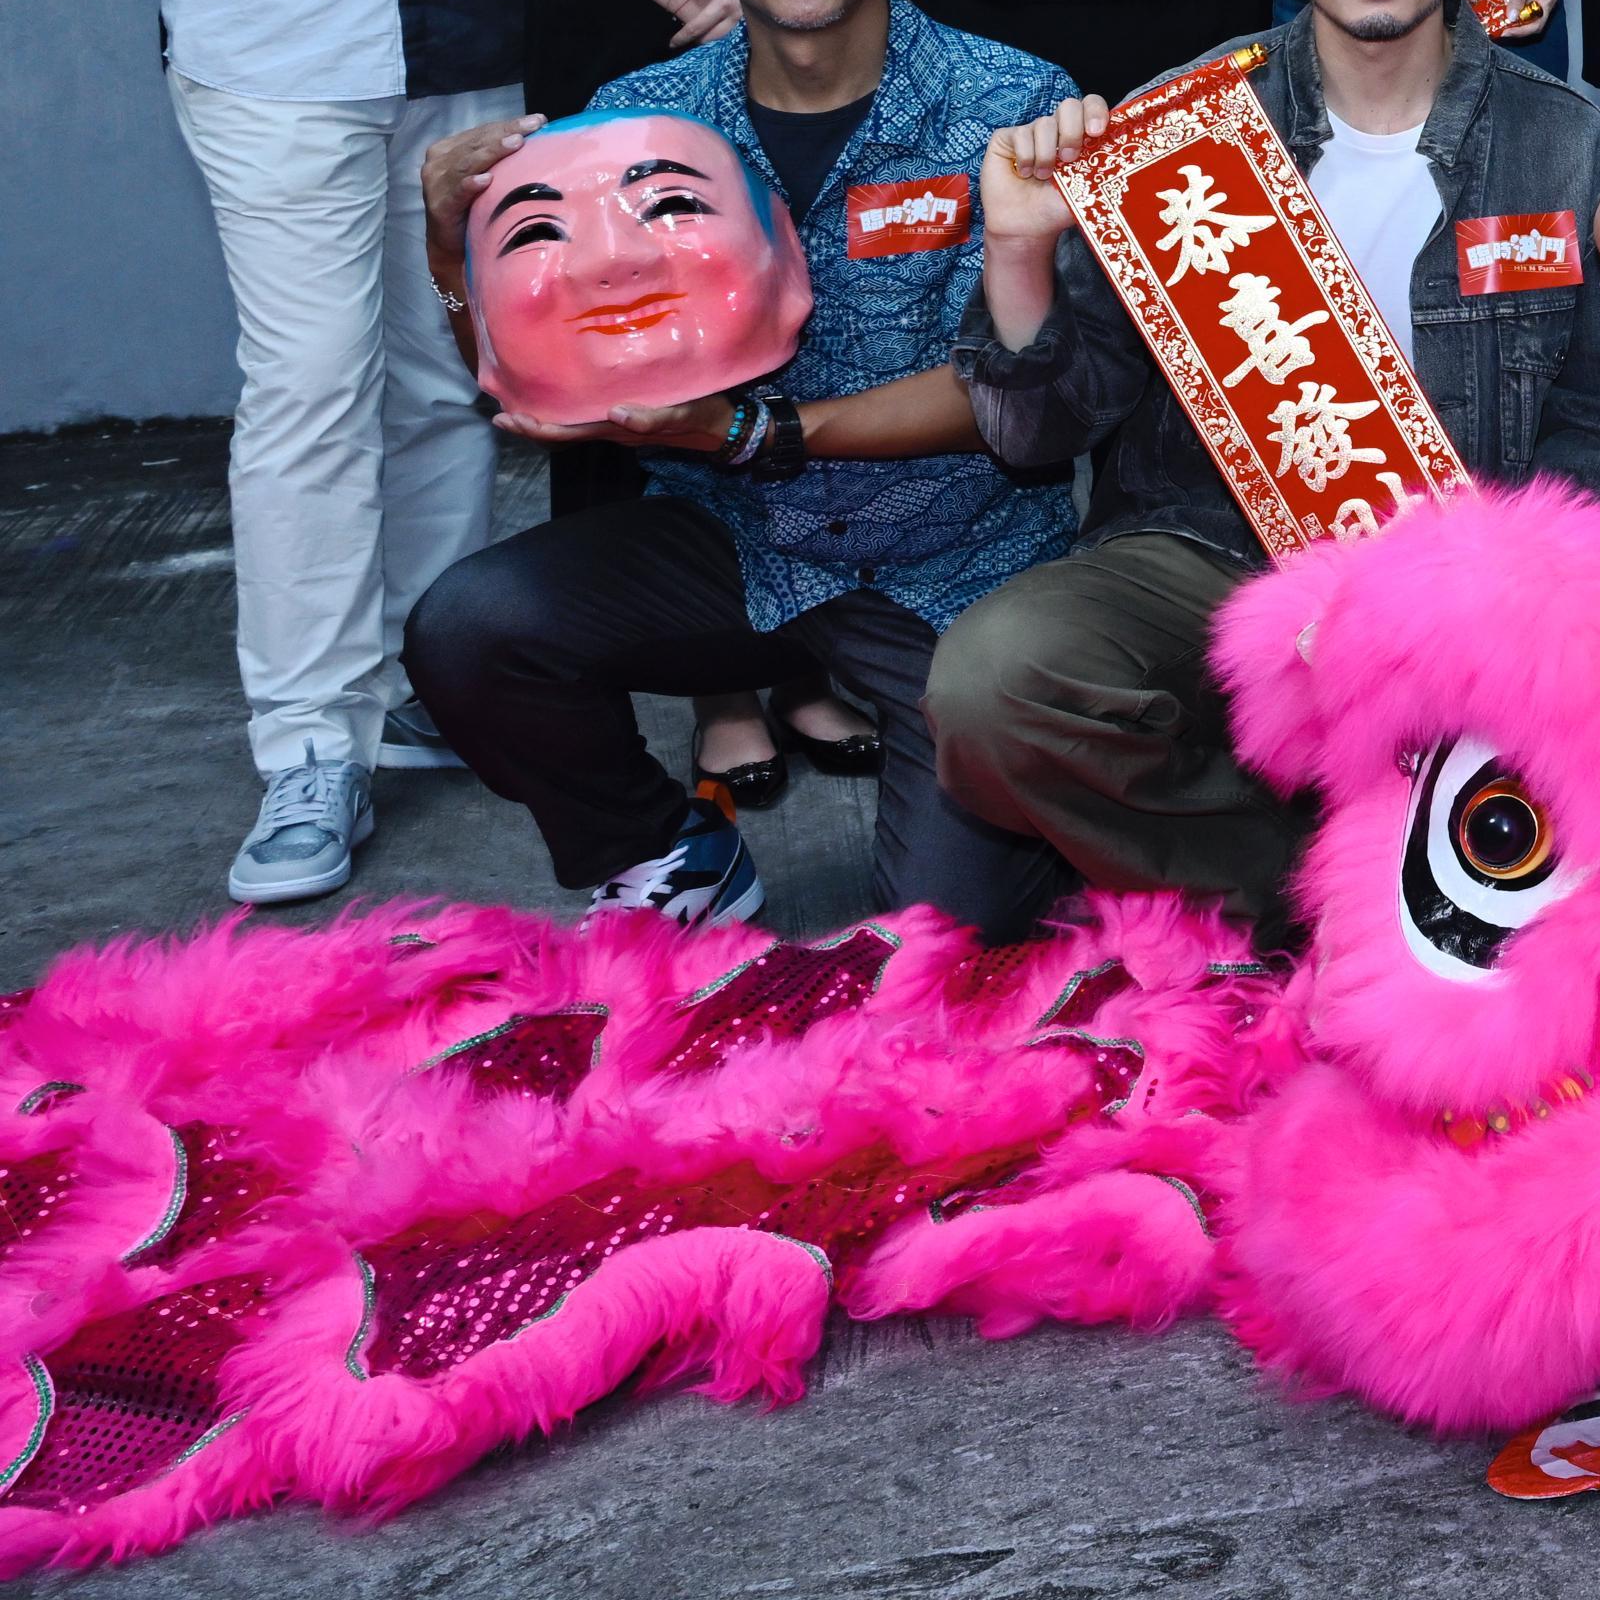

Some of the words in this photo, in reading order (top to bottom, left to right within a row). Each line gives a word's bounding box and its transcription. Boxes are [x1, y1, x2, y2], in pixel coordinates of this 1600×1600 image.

[859, 191, 958, 233] 臨時決鬥
[1465, 228, 1567, 269] 臨時決鬥
